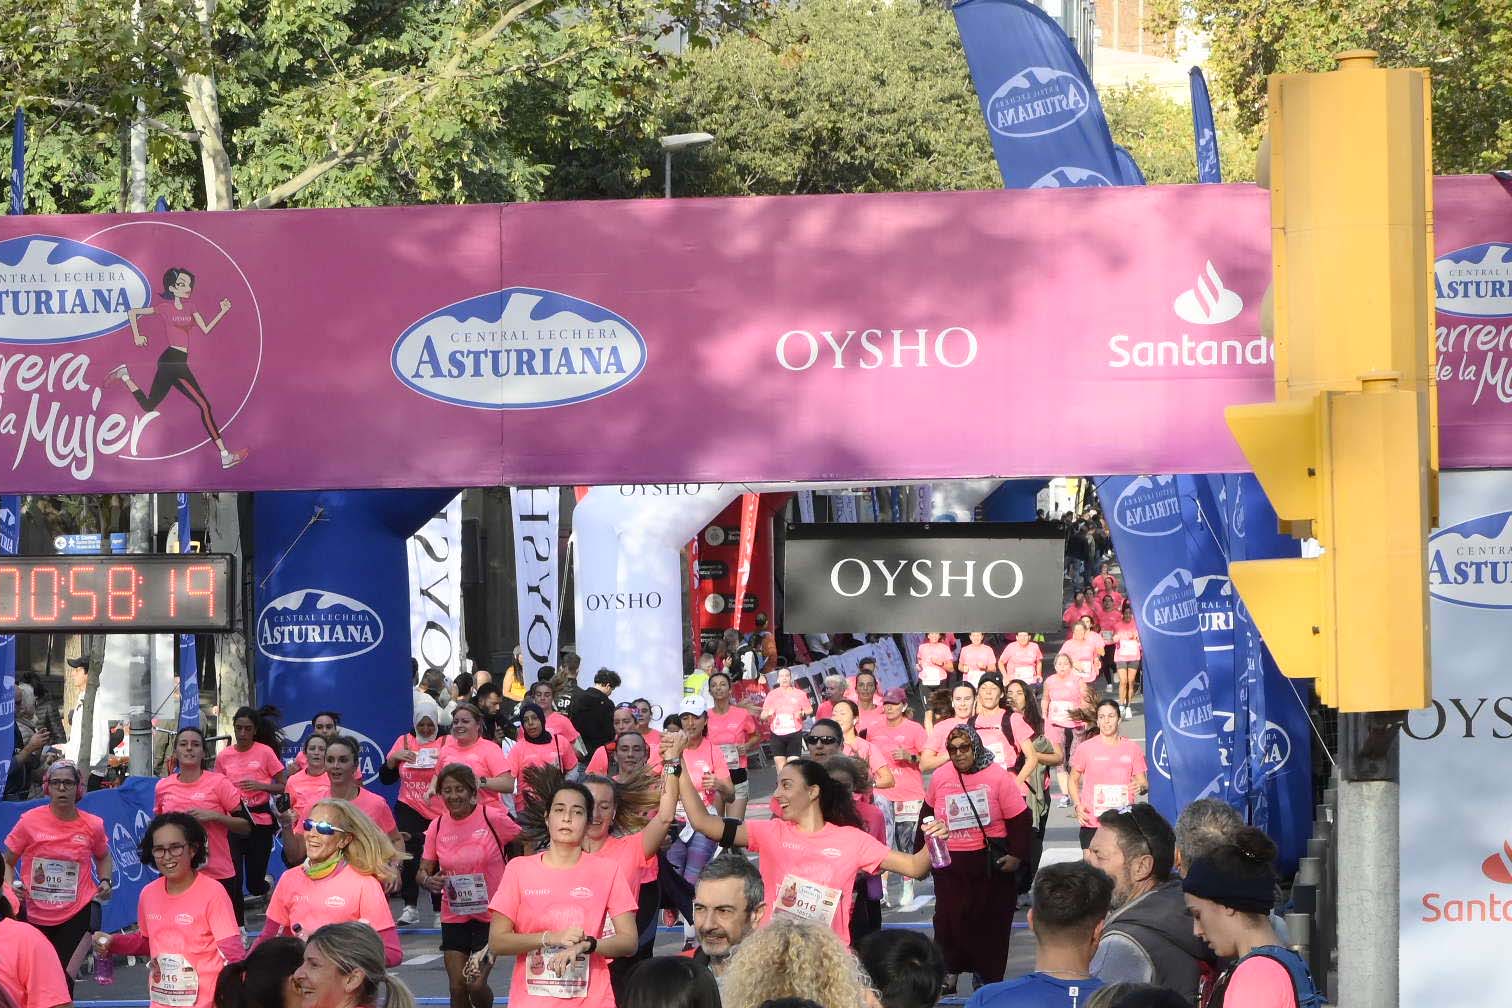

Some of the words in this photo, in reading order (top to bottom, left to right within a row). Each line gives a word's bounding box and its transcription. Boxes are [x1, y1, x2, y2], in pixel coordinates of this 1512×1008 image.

[54, 271, 126, 283] LECHERA
[450, 330, 530, 344] CENTRAL
[538, 328, 619, 342] LECHERA
[775, 326, 979, 372] OYSHO
[412, 335, 626, 379] ASTURIANA
[1109, 334, 1277, 368] Santand
[1458, 352, 1476, 381] la
[12, 387, 161, 481] Mujer
[830, 557, 1024, 599] OYSHO
[586, 591, 662, 612] OYSHO
[274, 613, 317, 623] CENTRAL
[262, 621, 374, 647] ASTURIANA
[797, 899, 817, 912] 016
